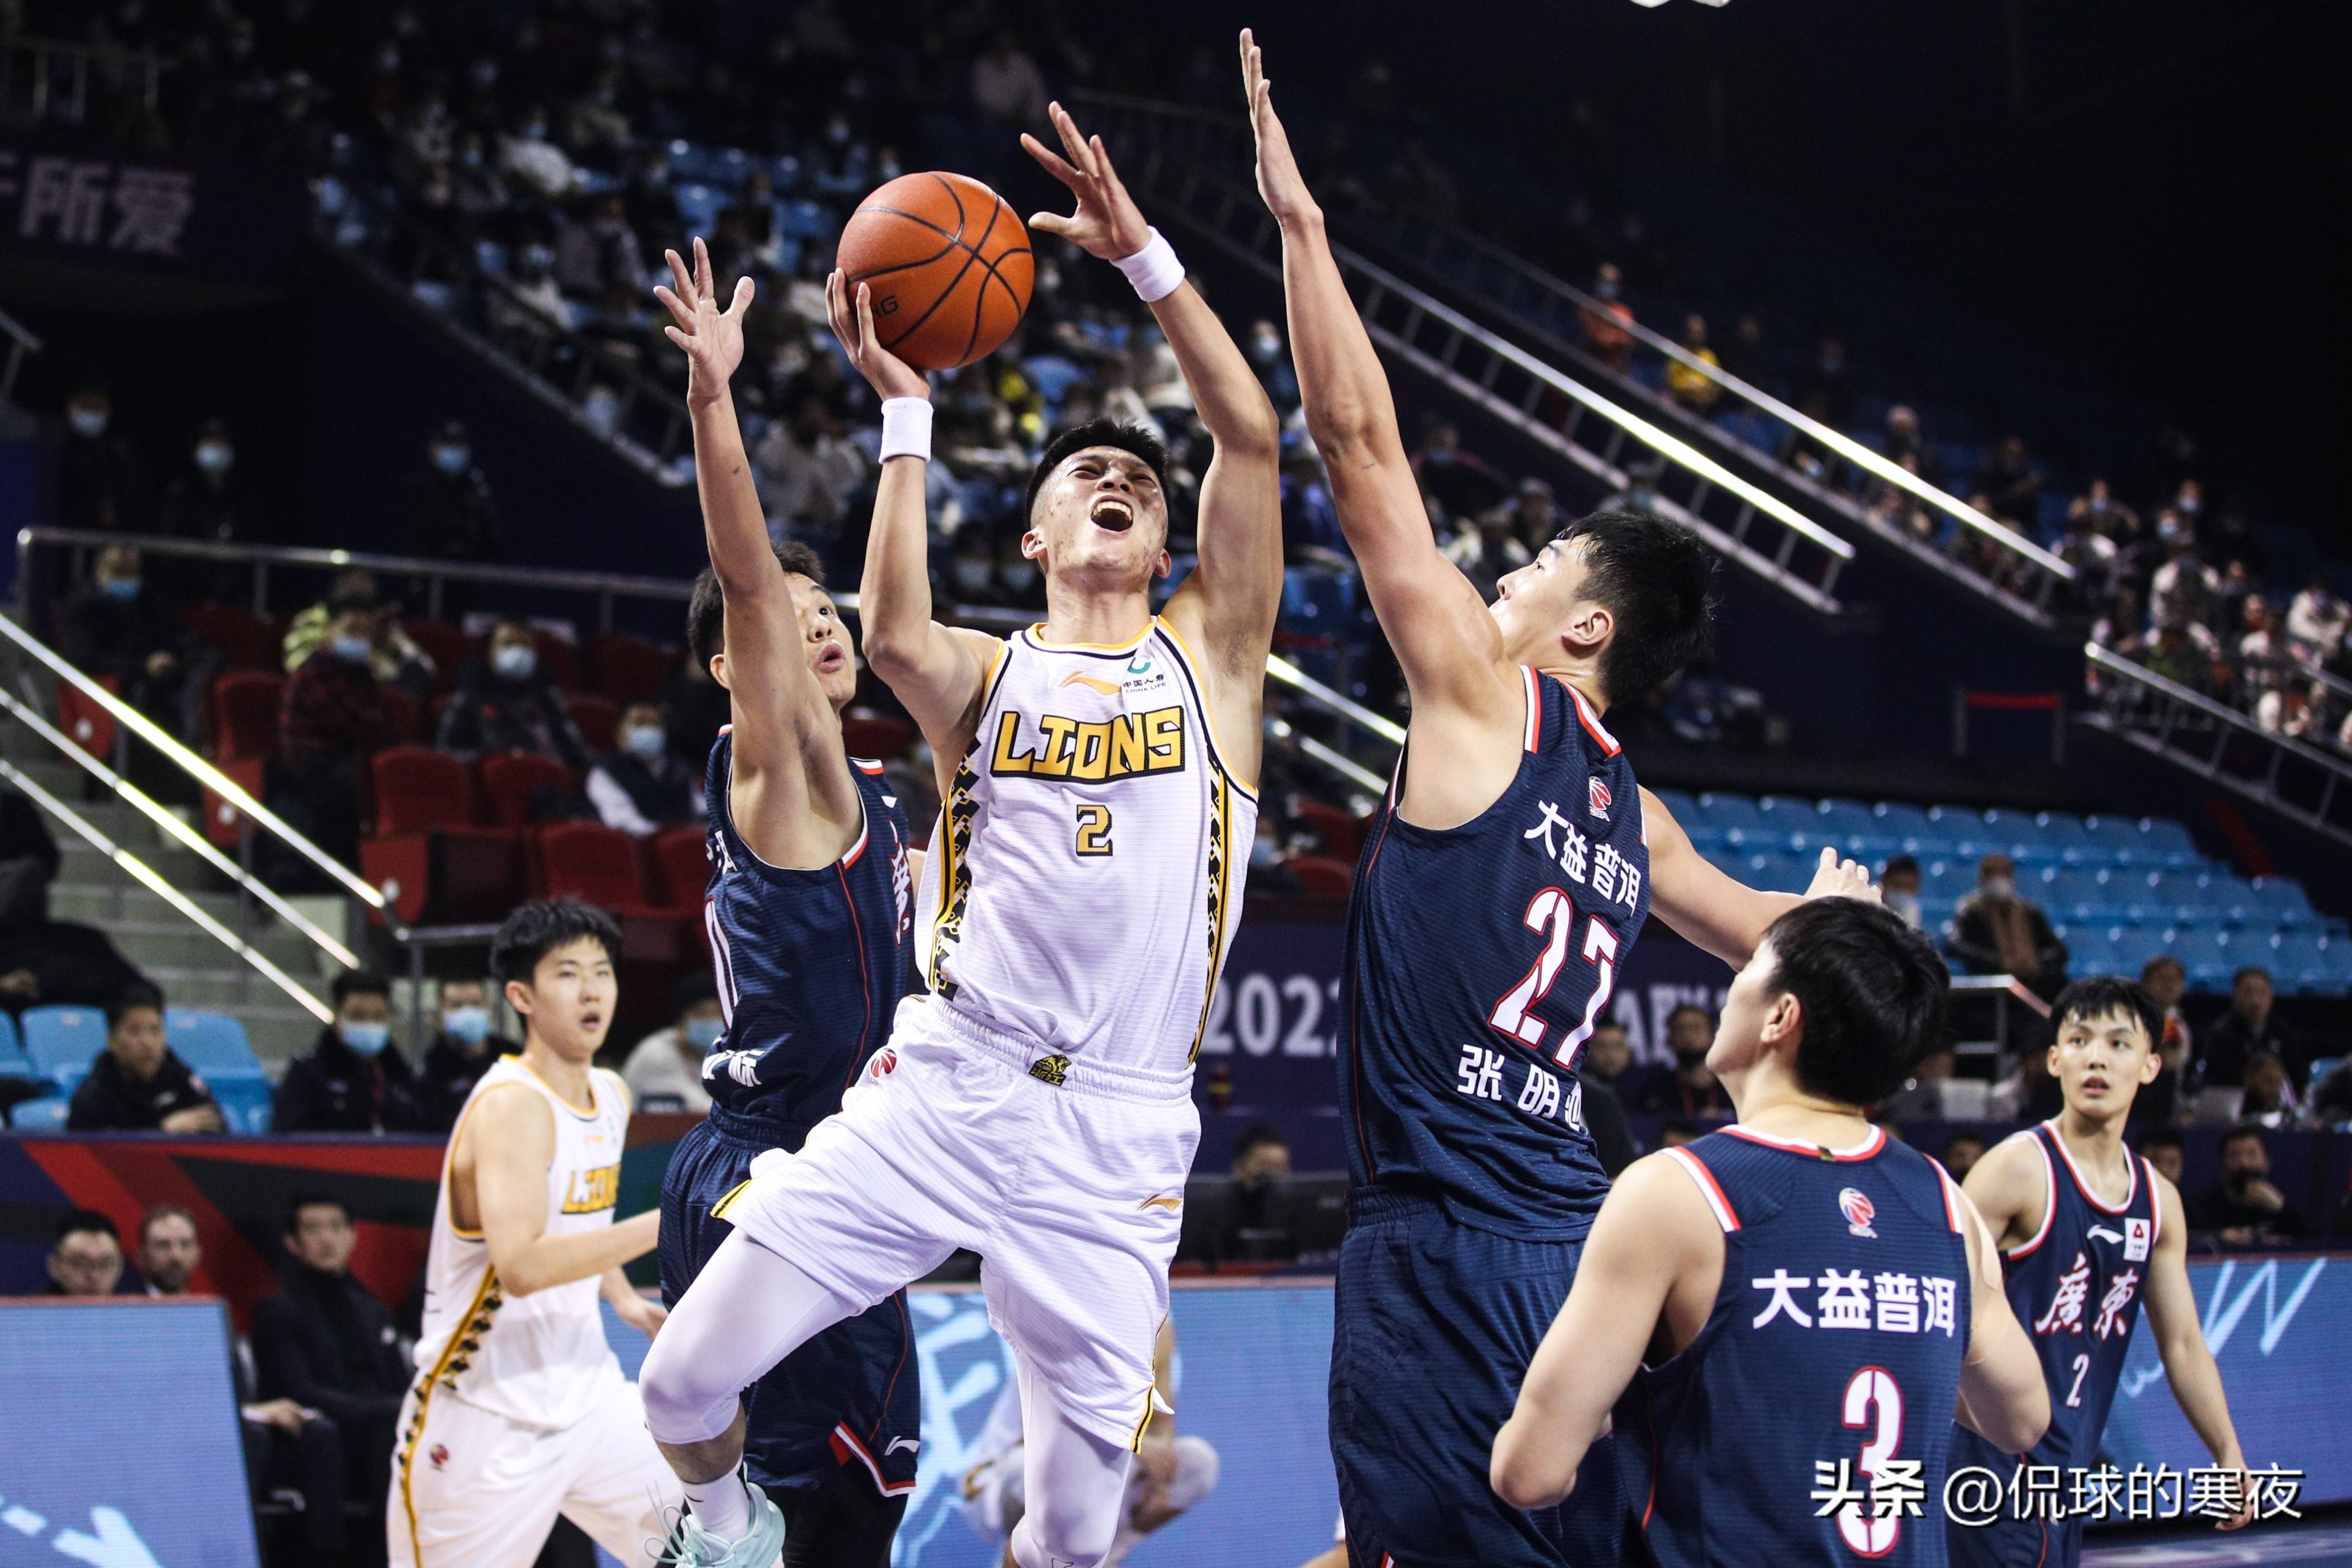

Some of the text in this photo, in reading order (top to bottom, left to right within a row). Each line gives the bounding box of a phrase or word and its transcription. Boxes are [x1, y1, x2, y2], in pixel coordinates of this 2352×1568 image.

[1123, 674, 1164, 688] 中国人寿
[1151, 682, 1167, 690] LIFE
[990, 705, 1185, 784] LIONS
[1075, 804, 1113, 857] 2
[1524, 799, 1641, 917] 大益普洱
[1488, 886, 1619, 1069] 27
[1752, 1268, 1956, 1337] 大益普洱
[2066, 1354, 2089, 1407] 2
[1838, 1365, 1904, 1559] 3
